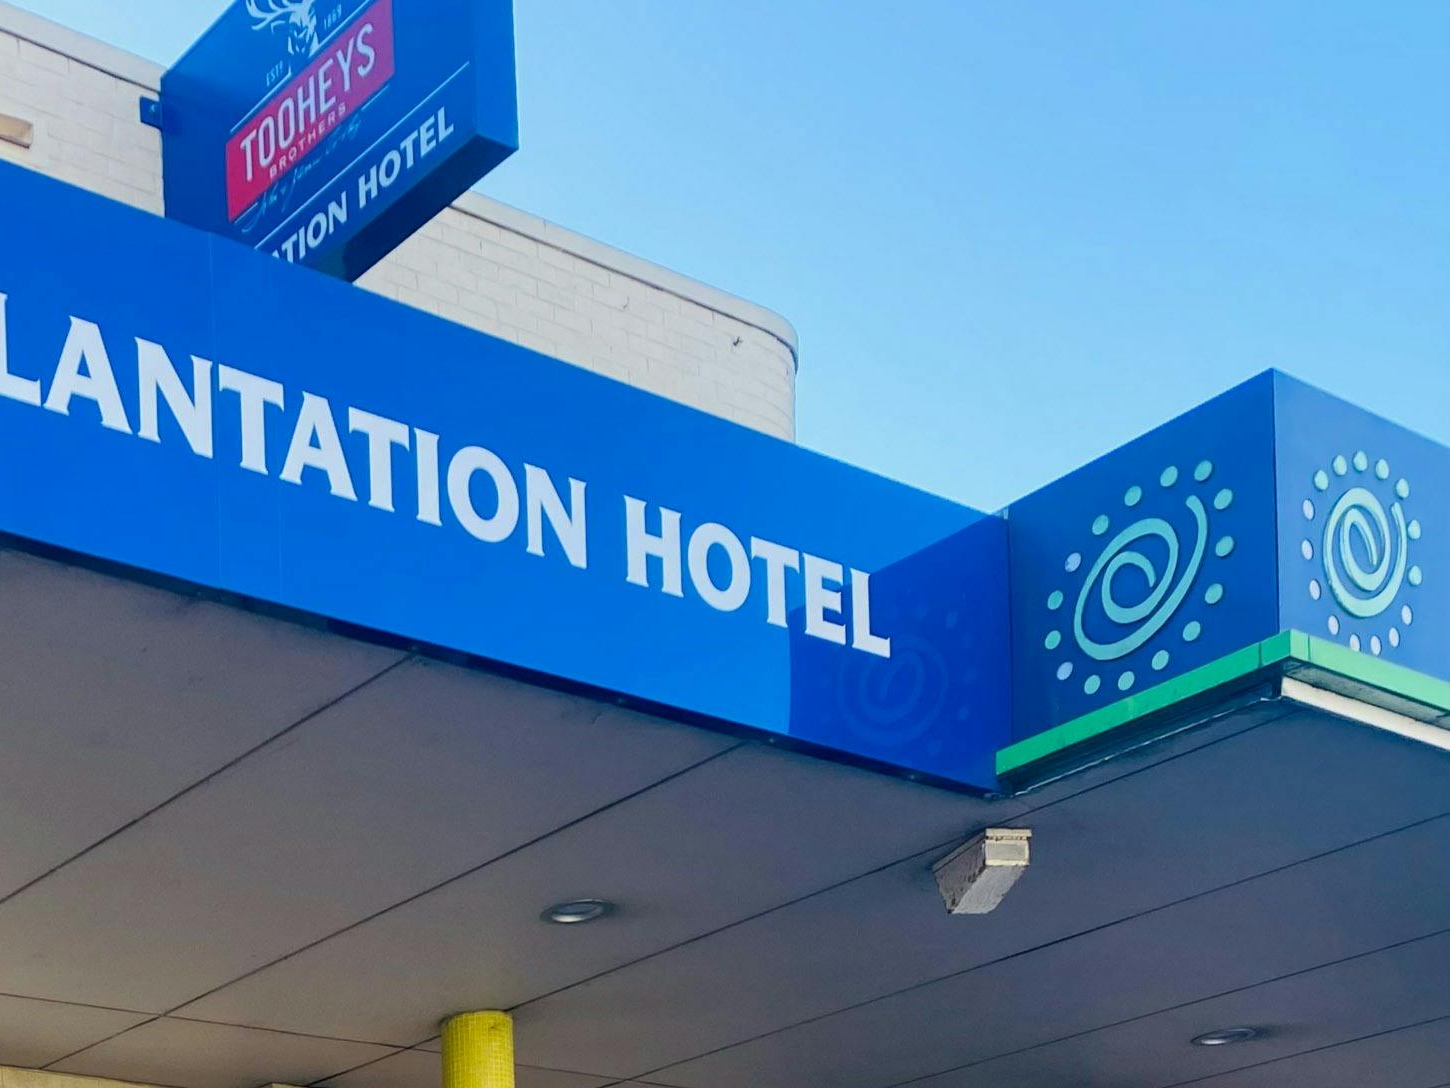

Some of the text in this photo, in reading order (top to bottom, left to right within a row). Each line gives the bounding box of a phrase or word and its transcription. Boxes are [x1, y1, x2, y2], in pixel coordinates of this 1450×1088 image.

[240, 22, 376, 182] TOOHEYS
[269, 101, 346, 180] BROTHERS
[272, 190, 348, 264] TION
[358, 106, 454, 209] HOTEL
[623, 494, 891, 658] HOTEL
